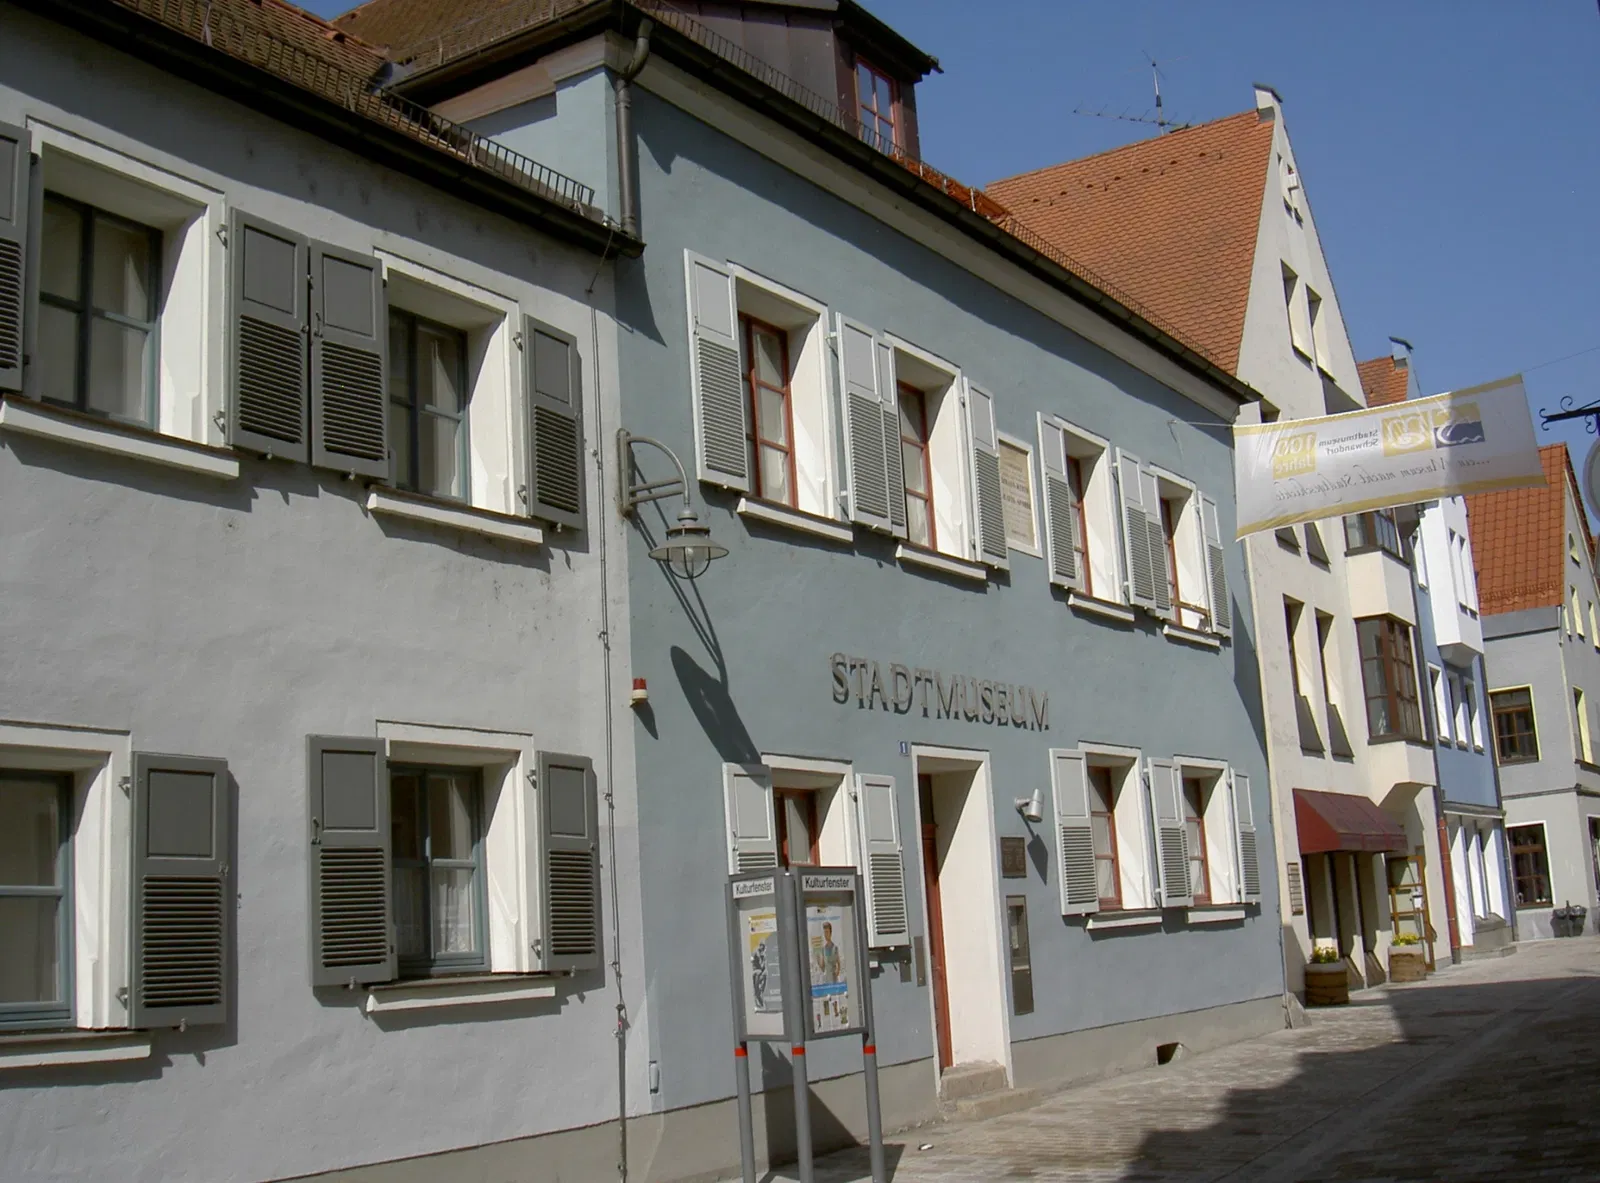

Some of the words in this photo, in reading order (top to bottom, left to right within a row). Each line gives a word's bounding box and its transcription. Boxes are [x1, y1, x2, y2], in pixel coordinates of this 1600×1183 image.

[830, 652, 1050, 731] STADTMUSEUM
[735, 881, 772, 895] Kulturfenster
[805, 877, 850, 889] Kulturfenster
